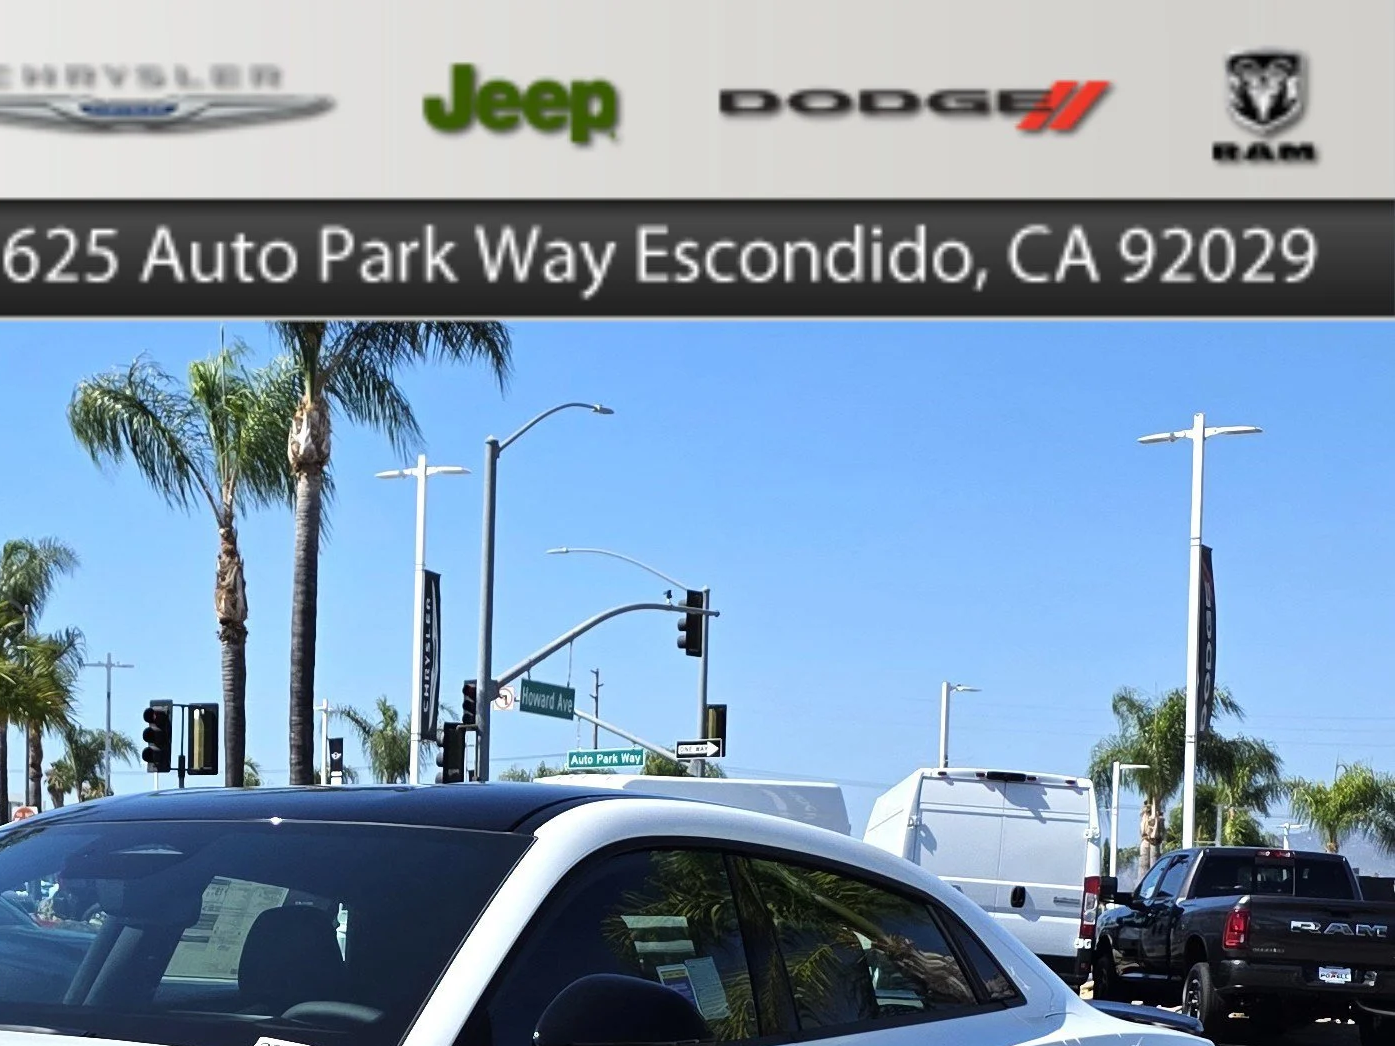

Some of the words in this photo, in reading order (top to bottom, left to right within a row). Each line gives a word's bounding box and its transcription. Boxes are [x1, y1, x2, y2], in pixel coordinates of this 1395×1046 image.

[422, 597, 432, 713] CHRYSLER
[522, 686, 555, 710] Howard
[556, 692, 573, 713] Ave
[570, 754, 594, 765] Auto
[596, 753, 618, 765] Park
[621, 752, 642, 765] Way
[1290, 920, 1388, 938] RAM
